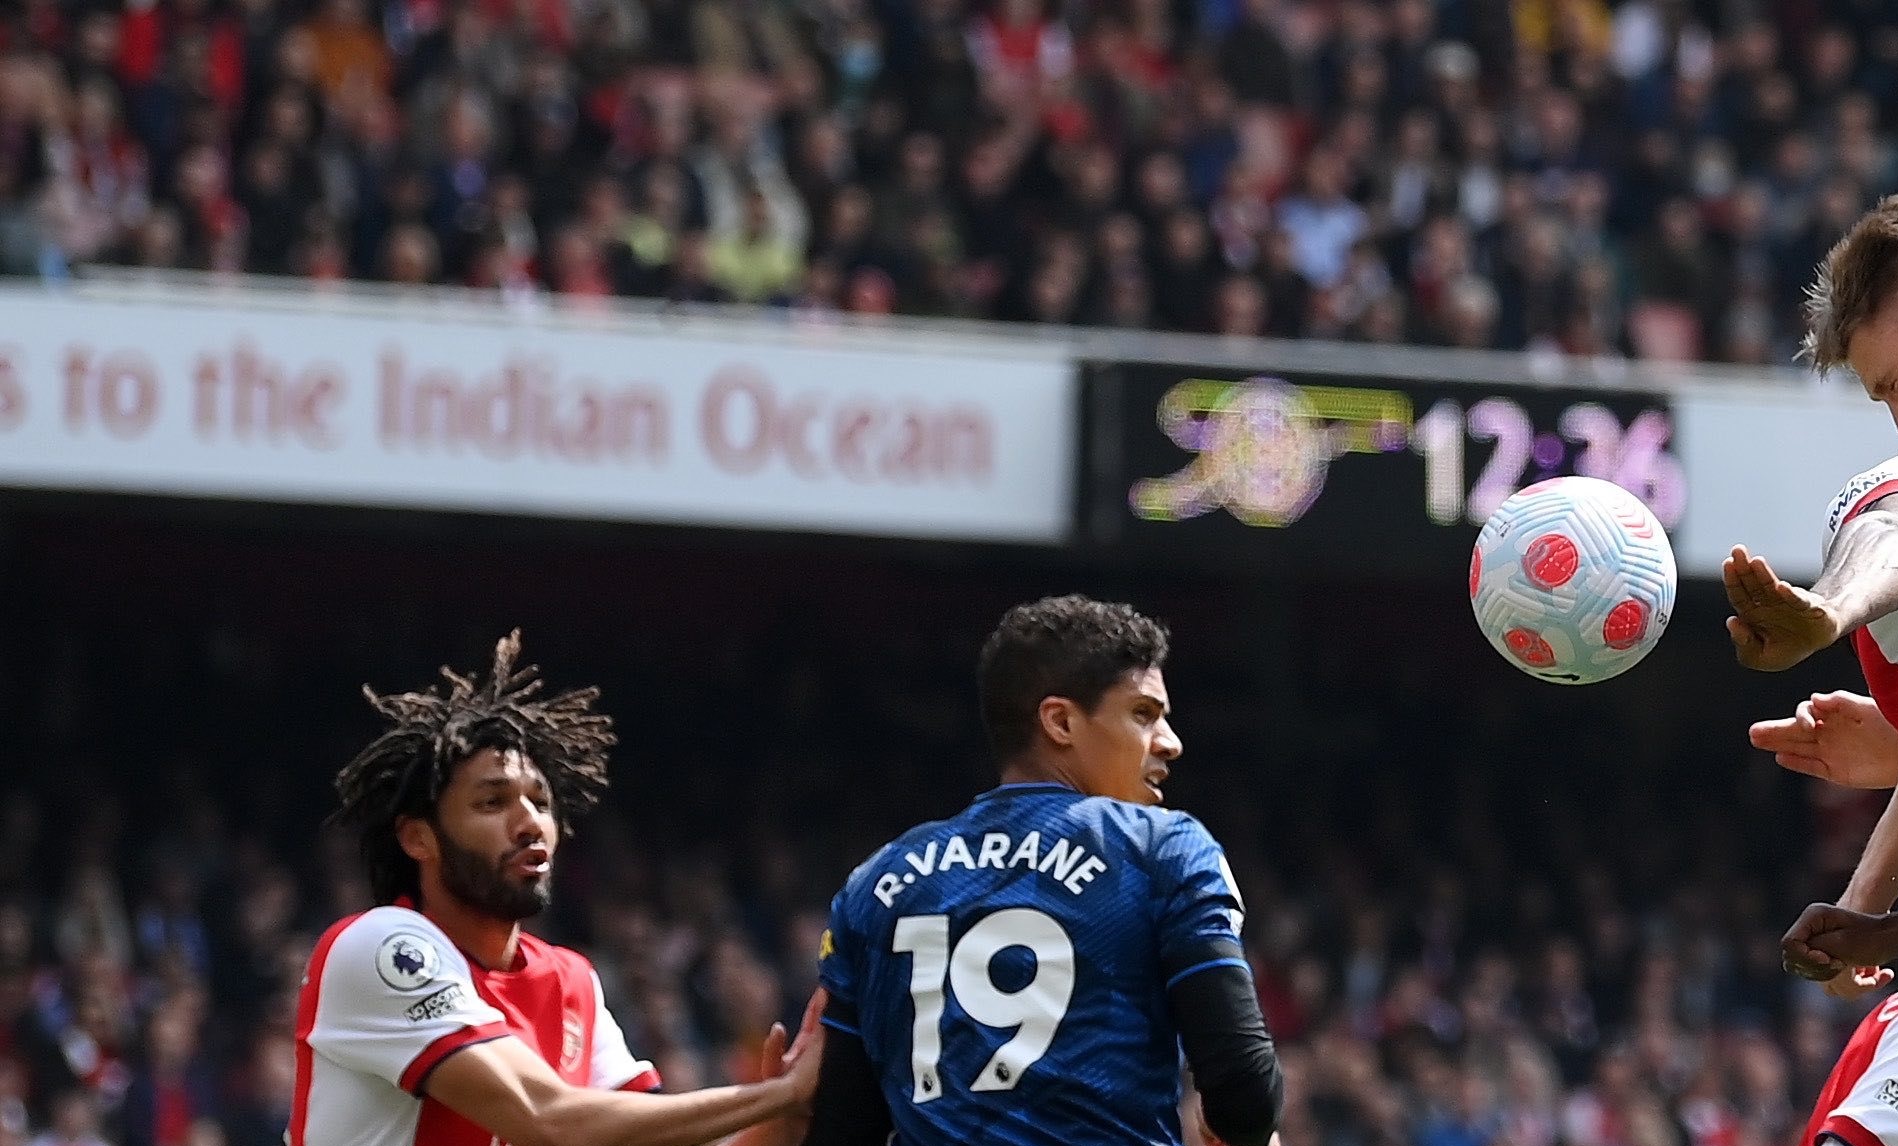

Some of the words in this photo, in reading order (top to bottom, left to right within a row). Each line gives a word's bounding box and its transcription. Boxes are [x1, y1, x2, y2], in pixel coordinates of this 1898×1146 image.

[61, 345, 158, 438] to
[193, 332, 342, 450] the
[376, 343, 670, 464] Indian
[700, 363, 995, 483] Ocean
[873, 831, 1107, 907] R.VARANE
[892, 908, 1075, 1104] 19
